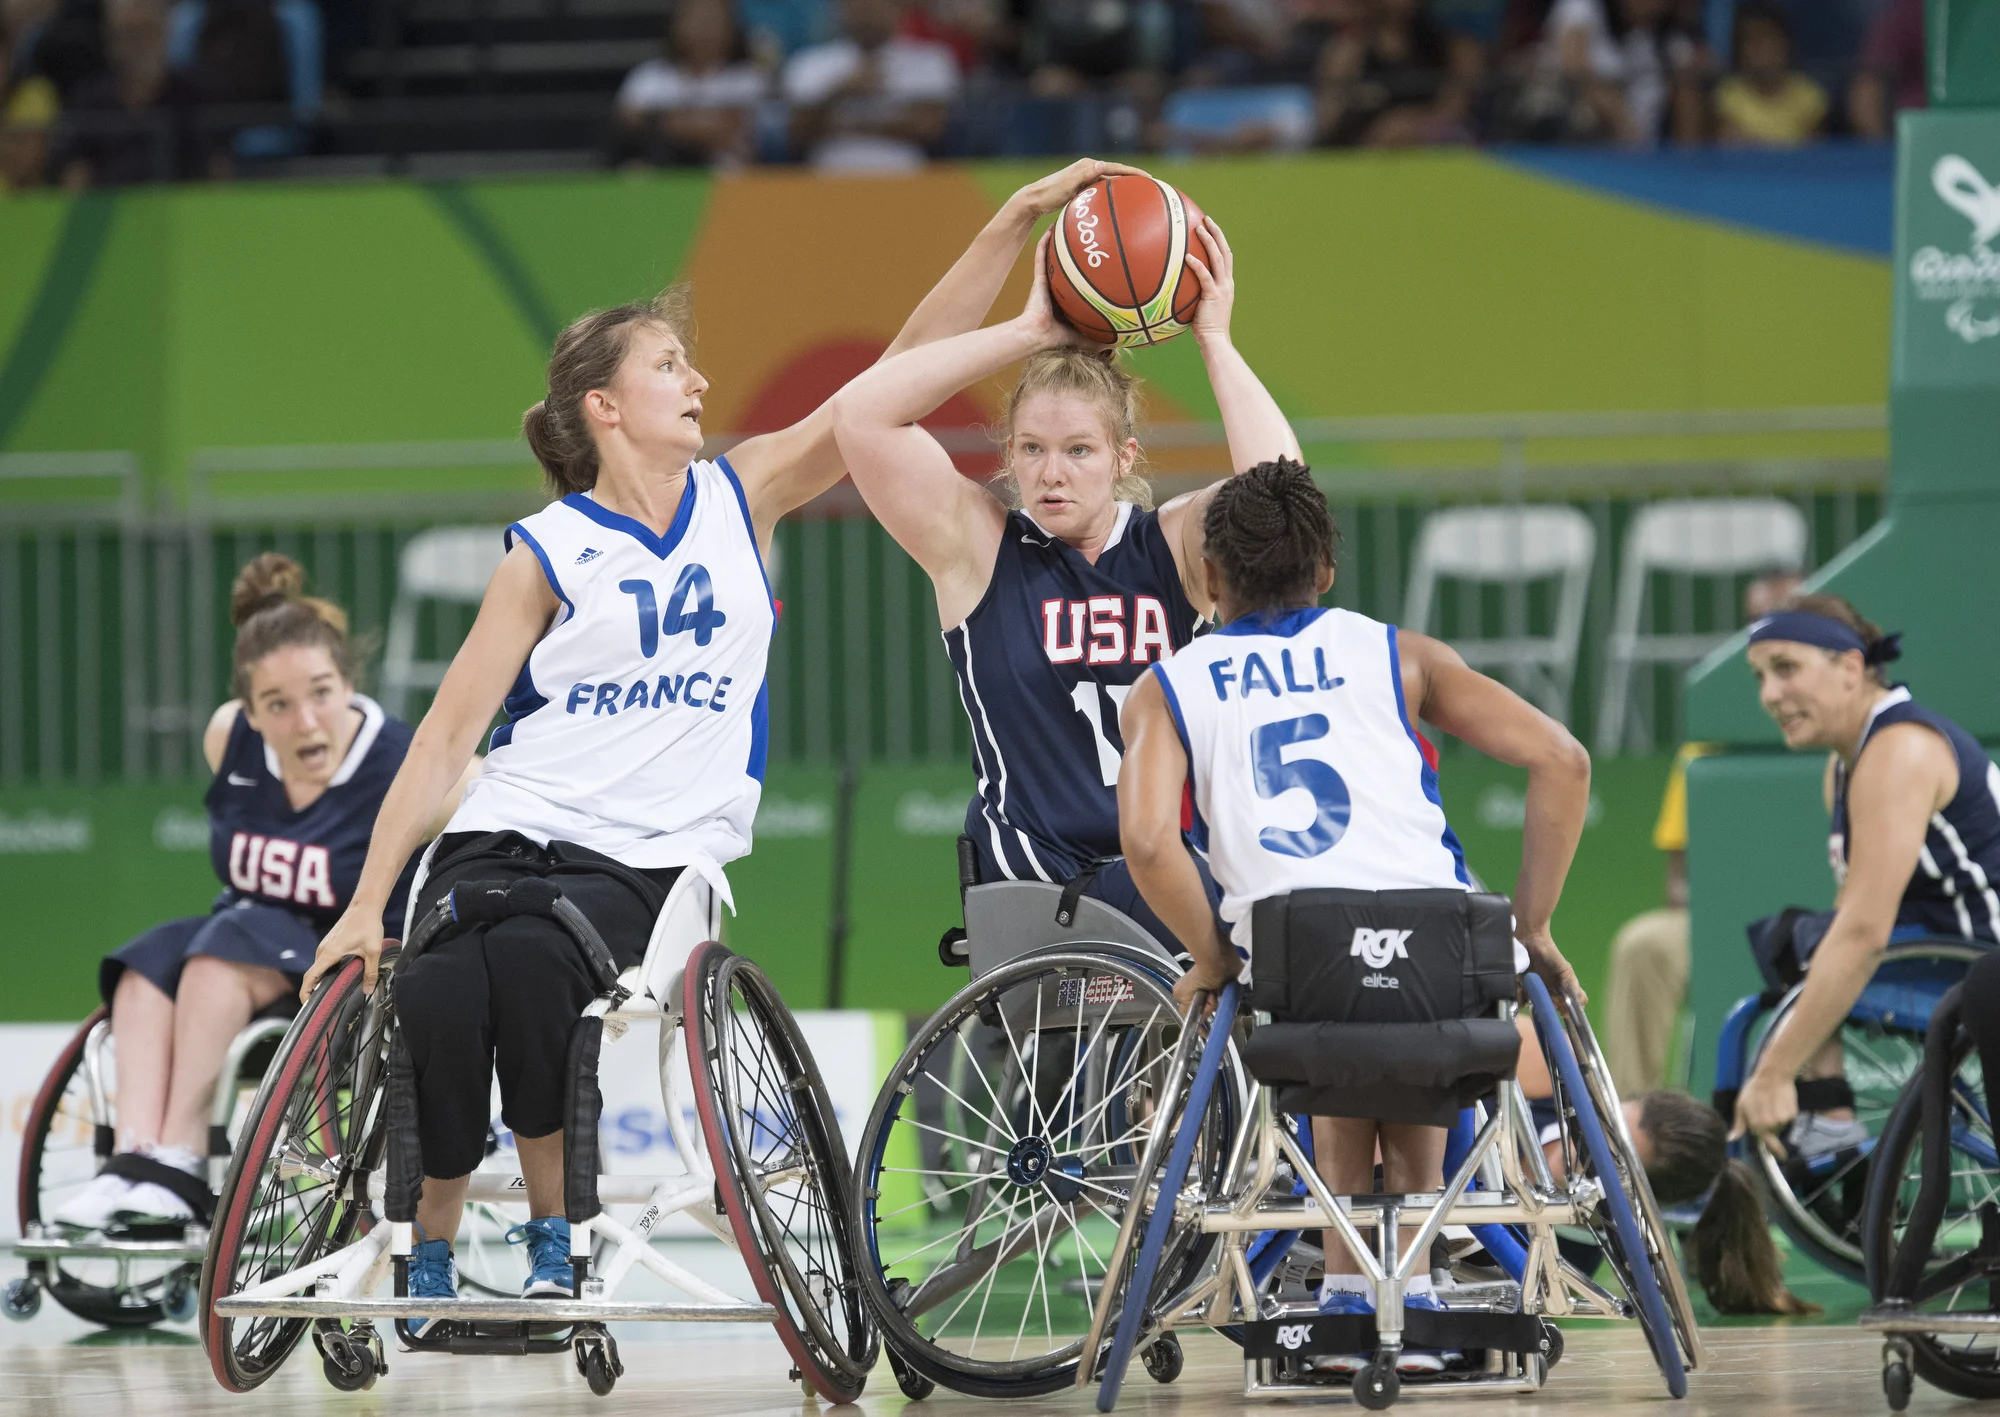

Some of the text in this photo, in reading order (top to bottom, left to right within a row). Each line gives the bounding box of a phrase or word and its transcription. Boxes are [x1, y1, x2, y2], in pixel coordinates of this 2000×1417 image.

[1077, 215, 1110, 268] 2016
[574, 550, 604, 565] adidas
[618, 563, 726, 659] 14
[1042, 595, 1175, 666] USA
[565, 671, 733, 716] FRANCE
[1208, 647, 1345, 701] FALL
[1250, 713, 1352, 859] 5
[229, 830, 338, 907] USA
[1362, 972, 1399, 989] elite
[639, 1205, 659, 1232] TOP END
